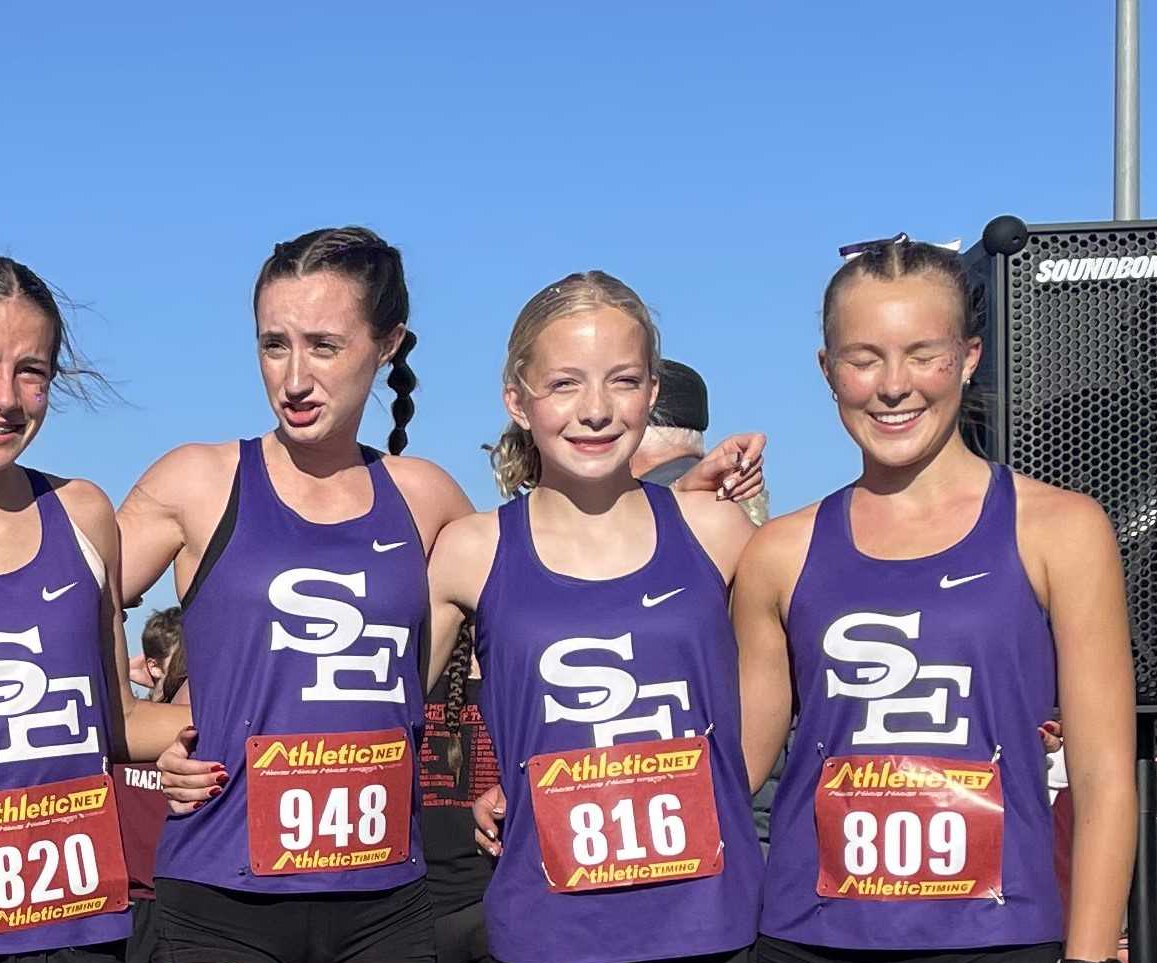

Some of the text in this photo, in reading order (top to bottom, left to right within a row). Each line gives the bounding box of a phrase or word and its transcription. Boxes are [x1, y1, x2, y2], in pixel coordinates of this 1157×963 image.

[279, 784, 387, 851] 948
[569, 793, 687, 866] 816
[843, 811, 967, 876] 809
